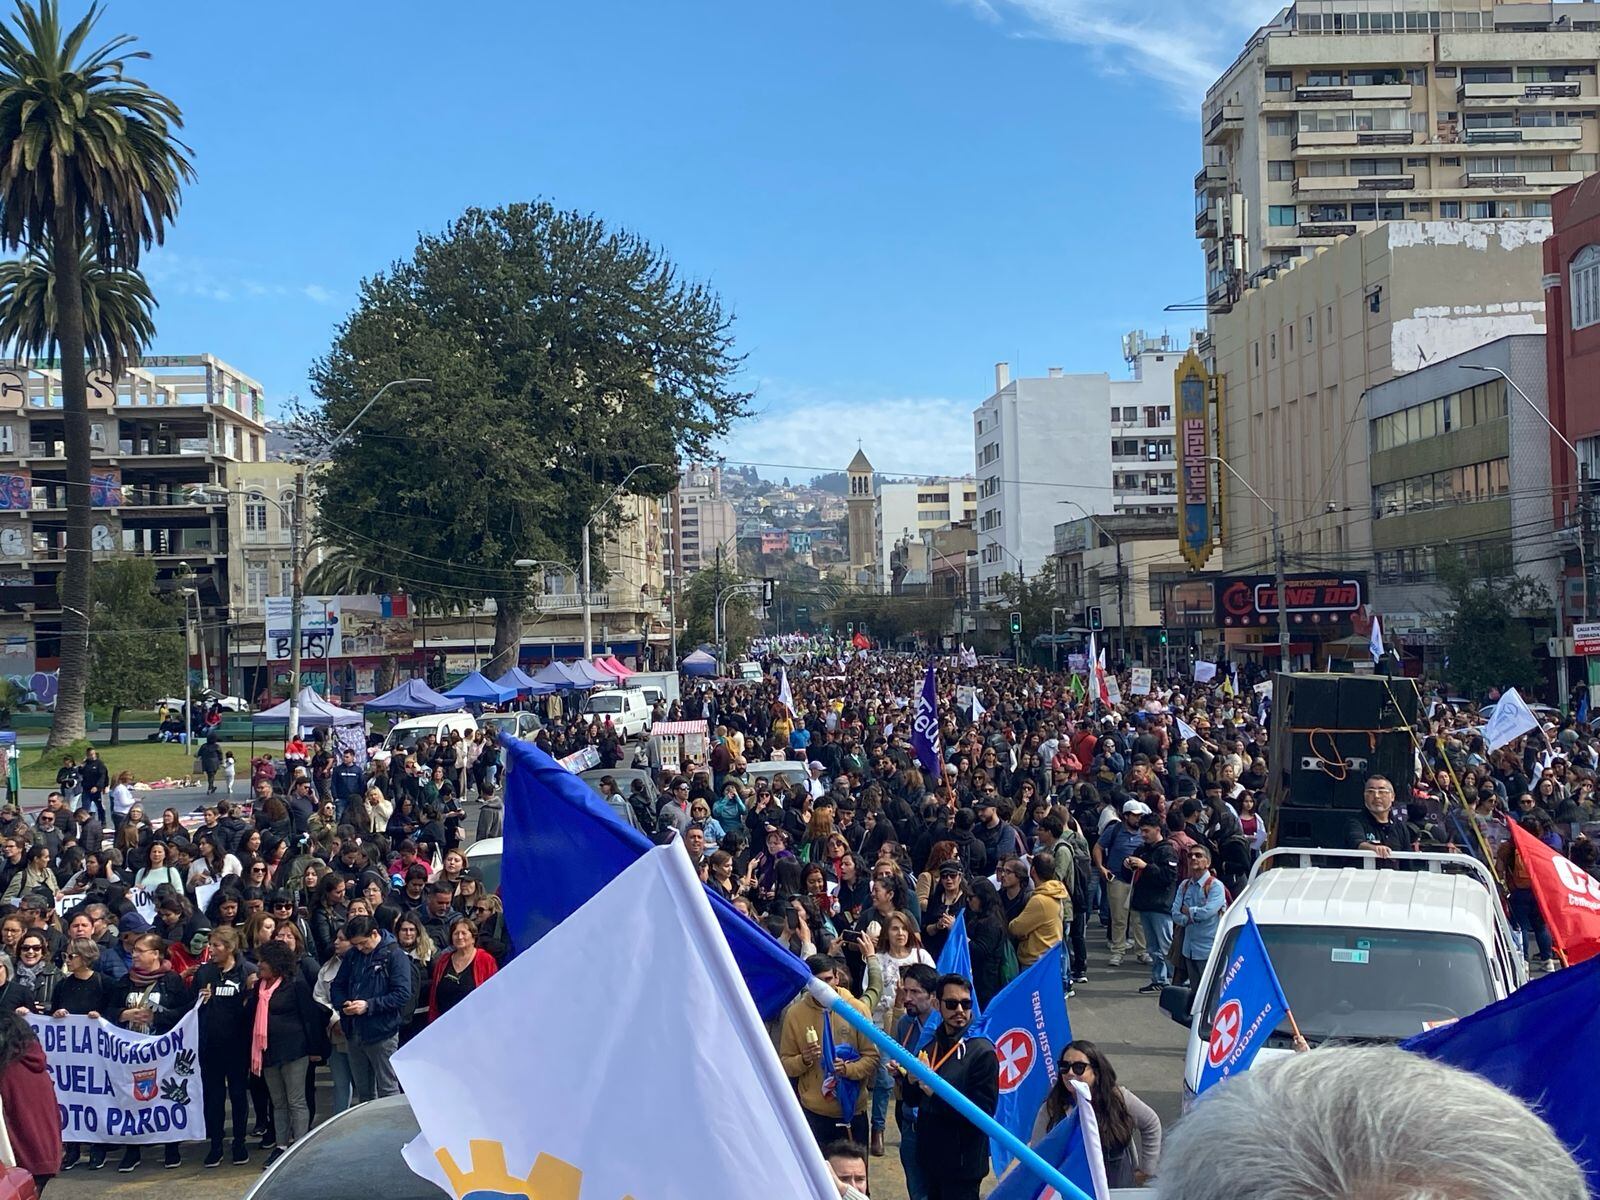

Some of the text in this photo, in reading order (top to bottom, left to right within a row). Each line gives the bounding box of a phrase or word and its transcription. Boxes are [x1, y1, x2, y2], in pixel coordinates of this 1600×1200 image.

[45, 1025, 66, 1053] DE
[72, 1025, 93, 1054] LA
[98, 1027, 184, 1065] EDUCACION
[1031, 990, 1059, 1086] FENATS HISTORIC
[106, 1103, 188, 1137] PARDO
